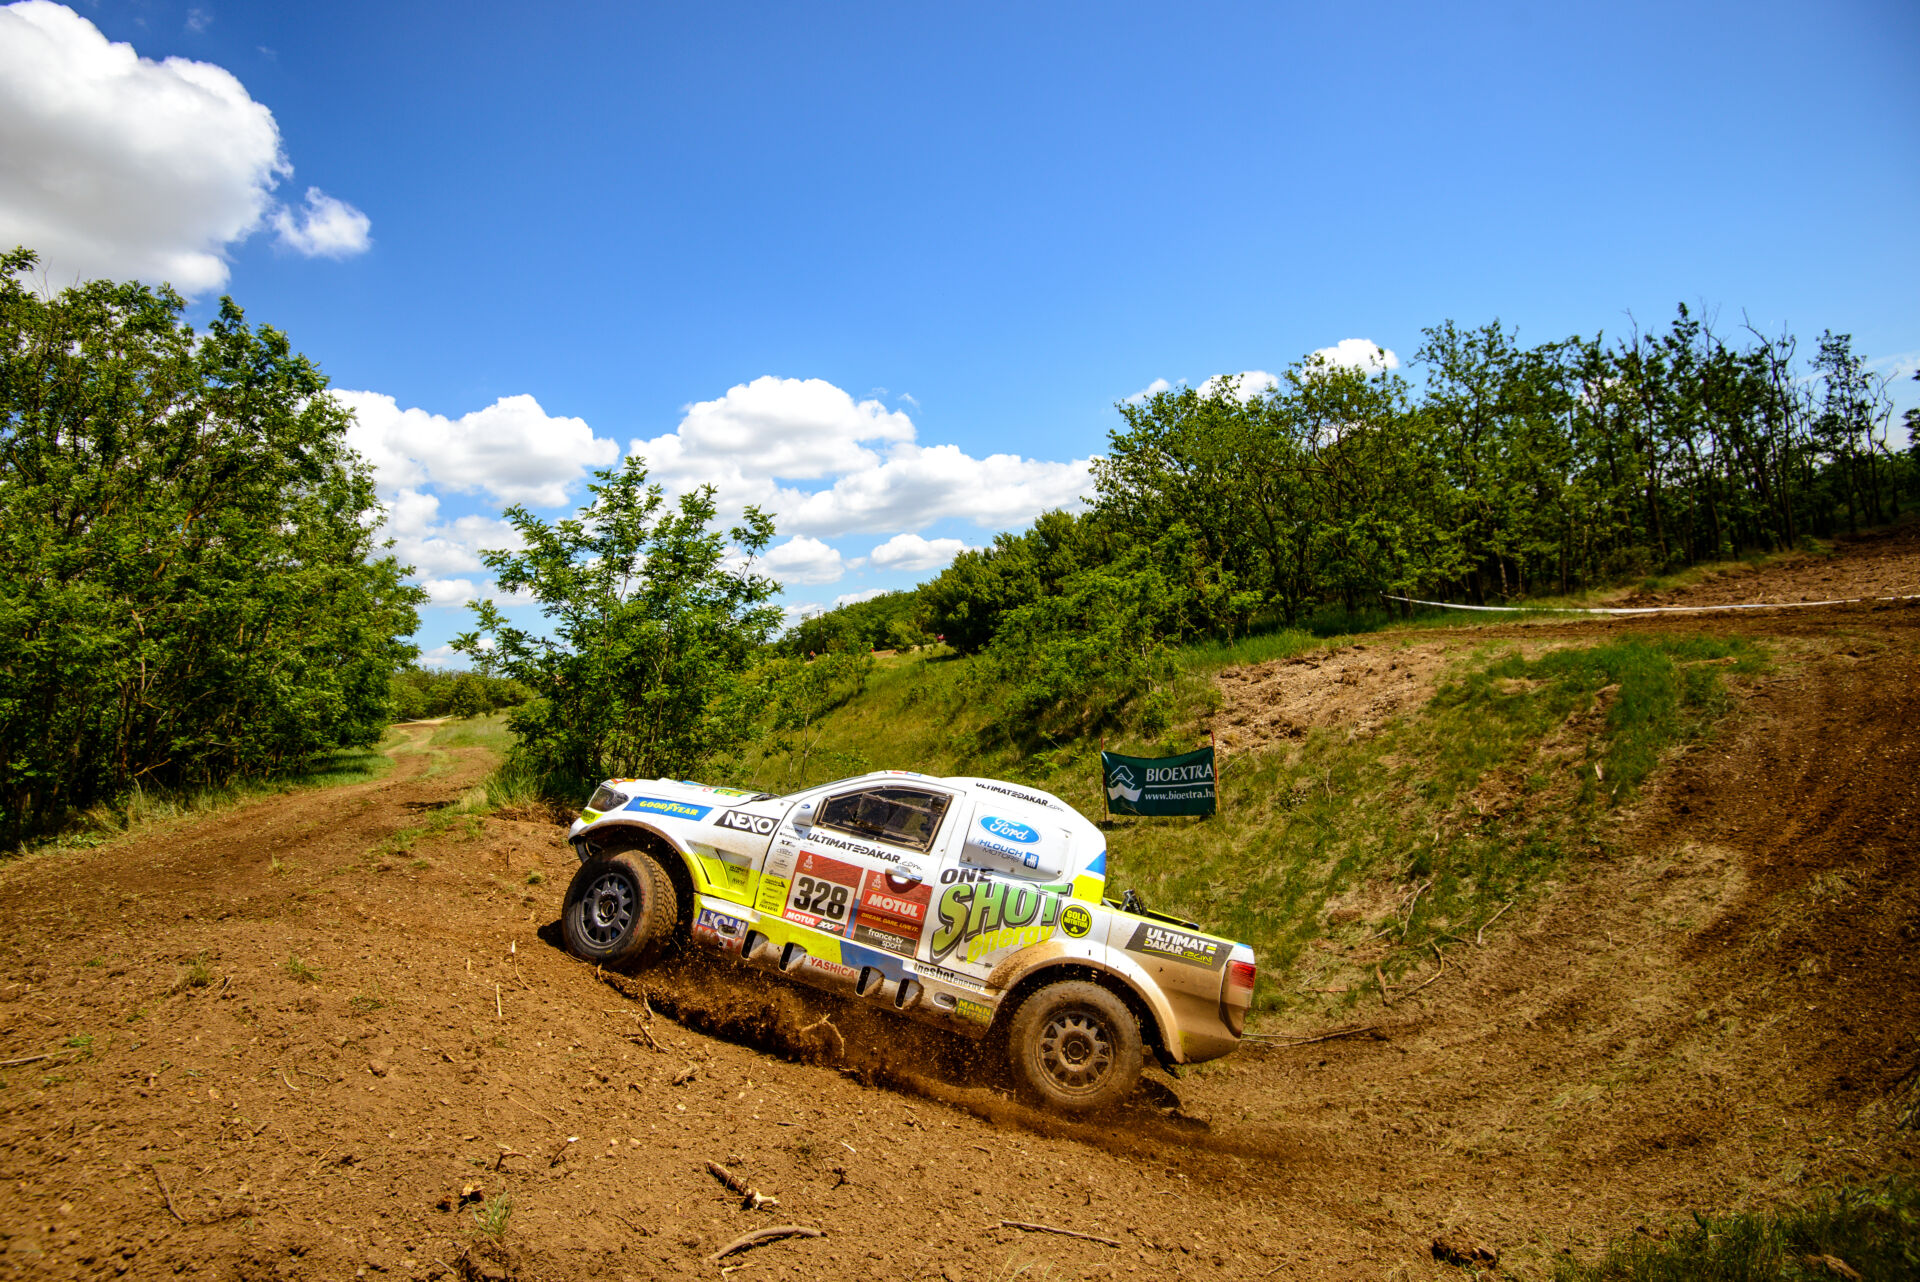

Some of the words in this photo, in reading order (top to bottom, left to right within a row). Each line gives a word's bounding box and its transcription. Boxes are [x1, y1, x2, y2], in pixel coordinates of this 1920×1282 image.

[1145, 763, 1214, 782] BIOEXTRA
[639, 800, 699, 816] GOODYEAR
[723, 811, 774, 834] NEXO
[989, 817, 1029, 841] Ford
[940, 868, 993, 884] ONE
[793, 876, 849, 920] 328
[867, 893, 919, 917] MOTUL
[785, 911, 816, 926] MOTUL
[816, 920, 844, 932] 300V
[929, 882, 1073, 965] SHOT
[1066, 909, 1088, 922] GOLD
[881, 940, 902, 951] sport
[966, 925, 1056, 964] energy
[1143, 937, 1184, 955] DAKAR
[1183, 950, 1213, 963] racing
[1146, 927, 1218, 955] ULTIMATE
[810, 956, 857, 980] YASHICA
[958, 999, 991, 1017] MANN
